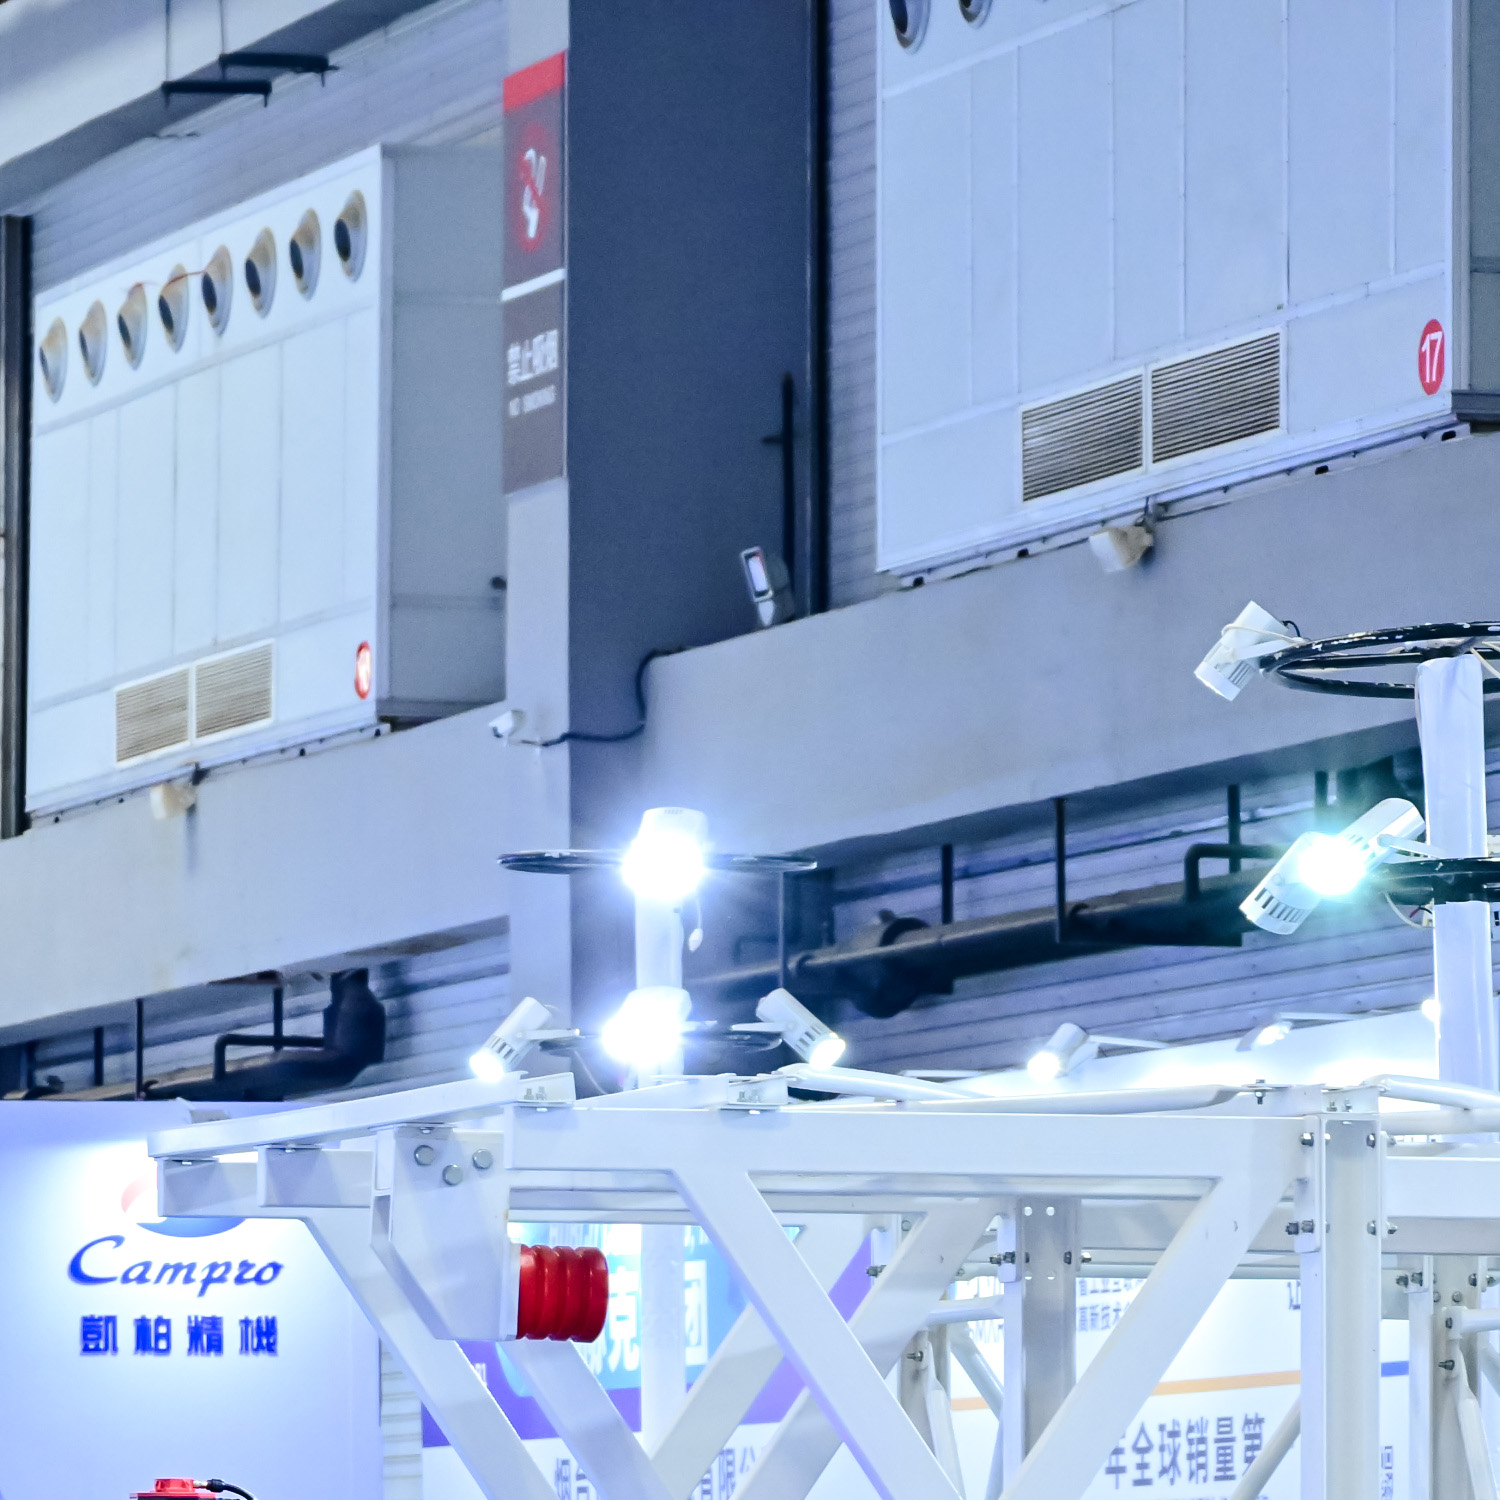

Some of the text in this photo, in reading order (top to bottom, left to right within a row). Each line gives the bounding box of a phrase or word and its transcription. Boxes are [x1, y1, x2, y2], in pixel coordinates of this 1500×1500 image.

[1421, 331, 1443, 384] 17
[69, 1234, 284, 1297] Campro
[80, 1314, 279, 1356] 凱柏精機
